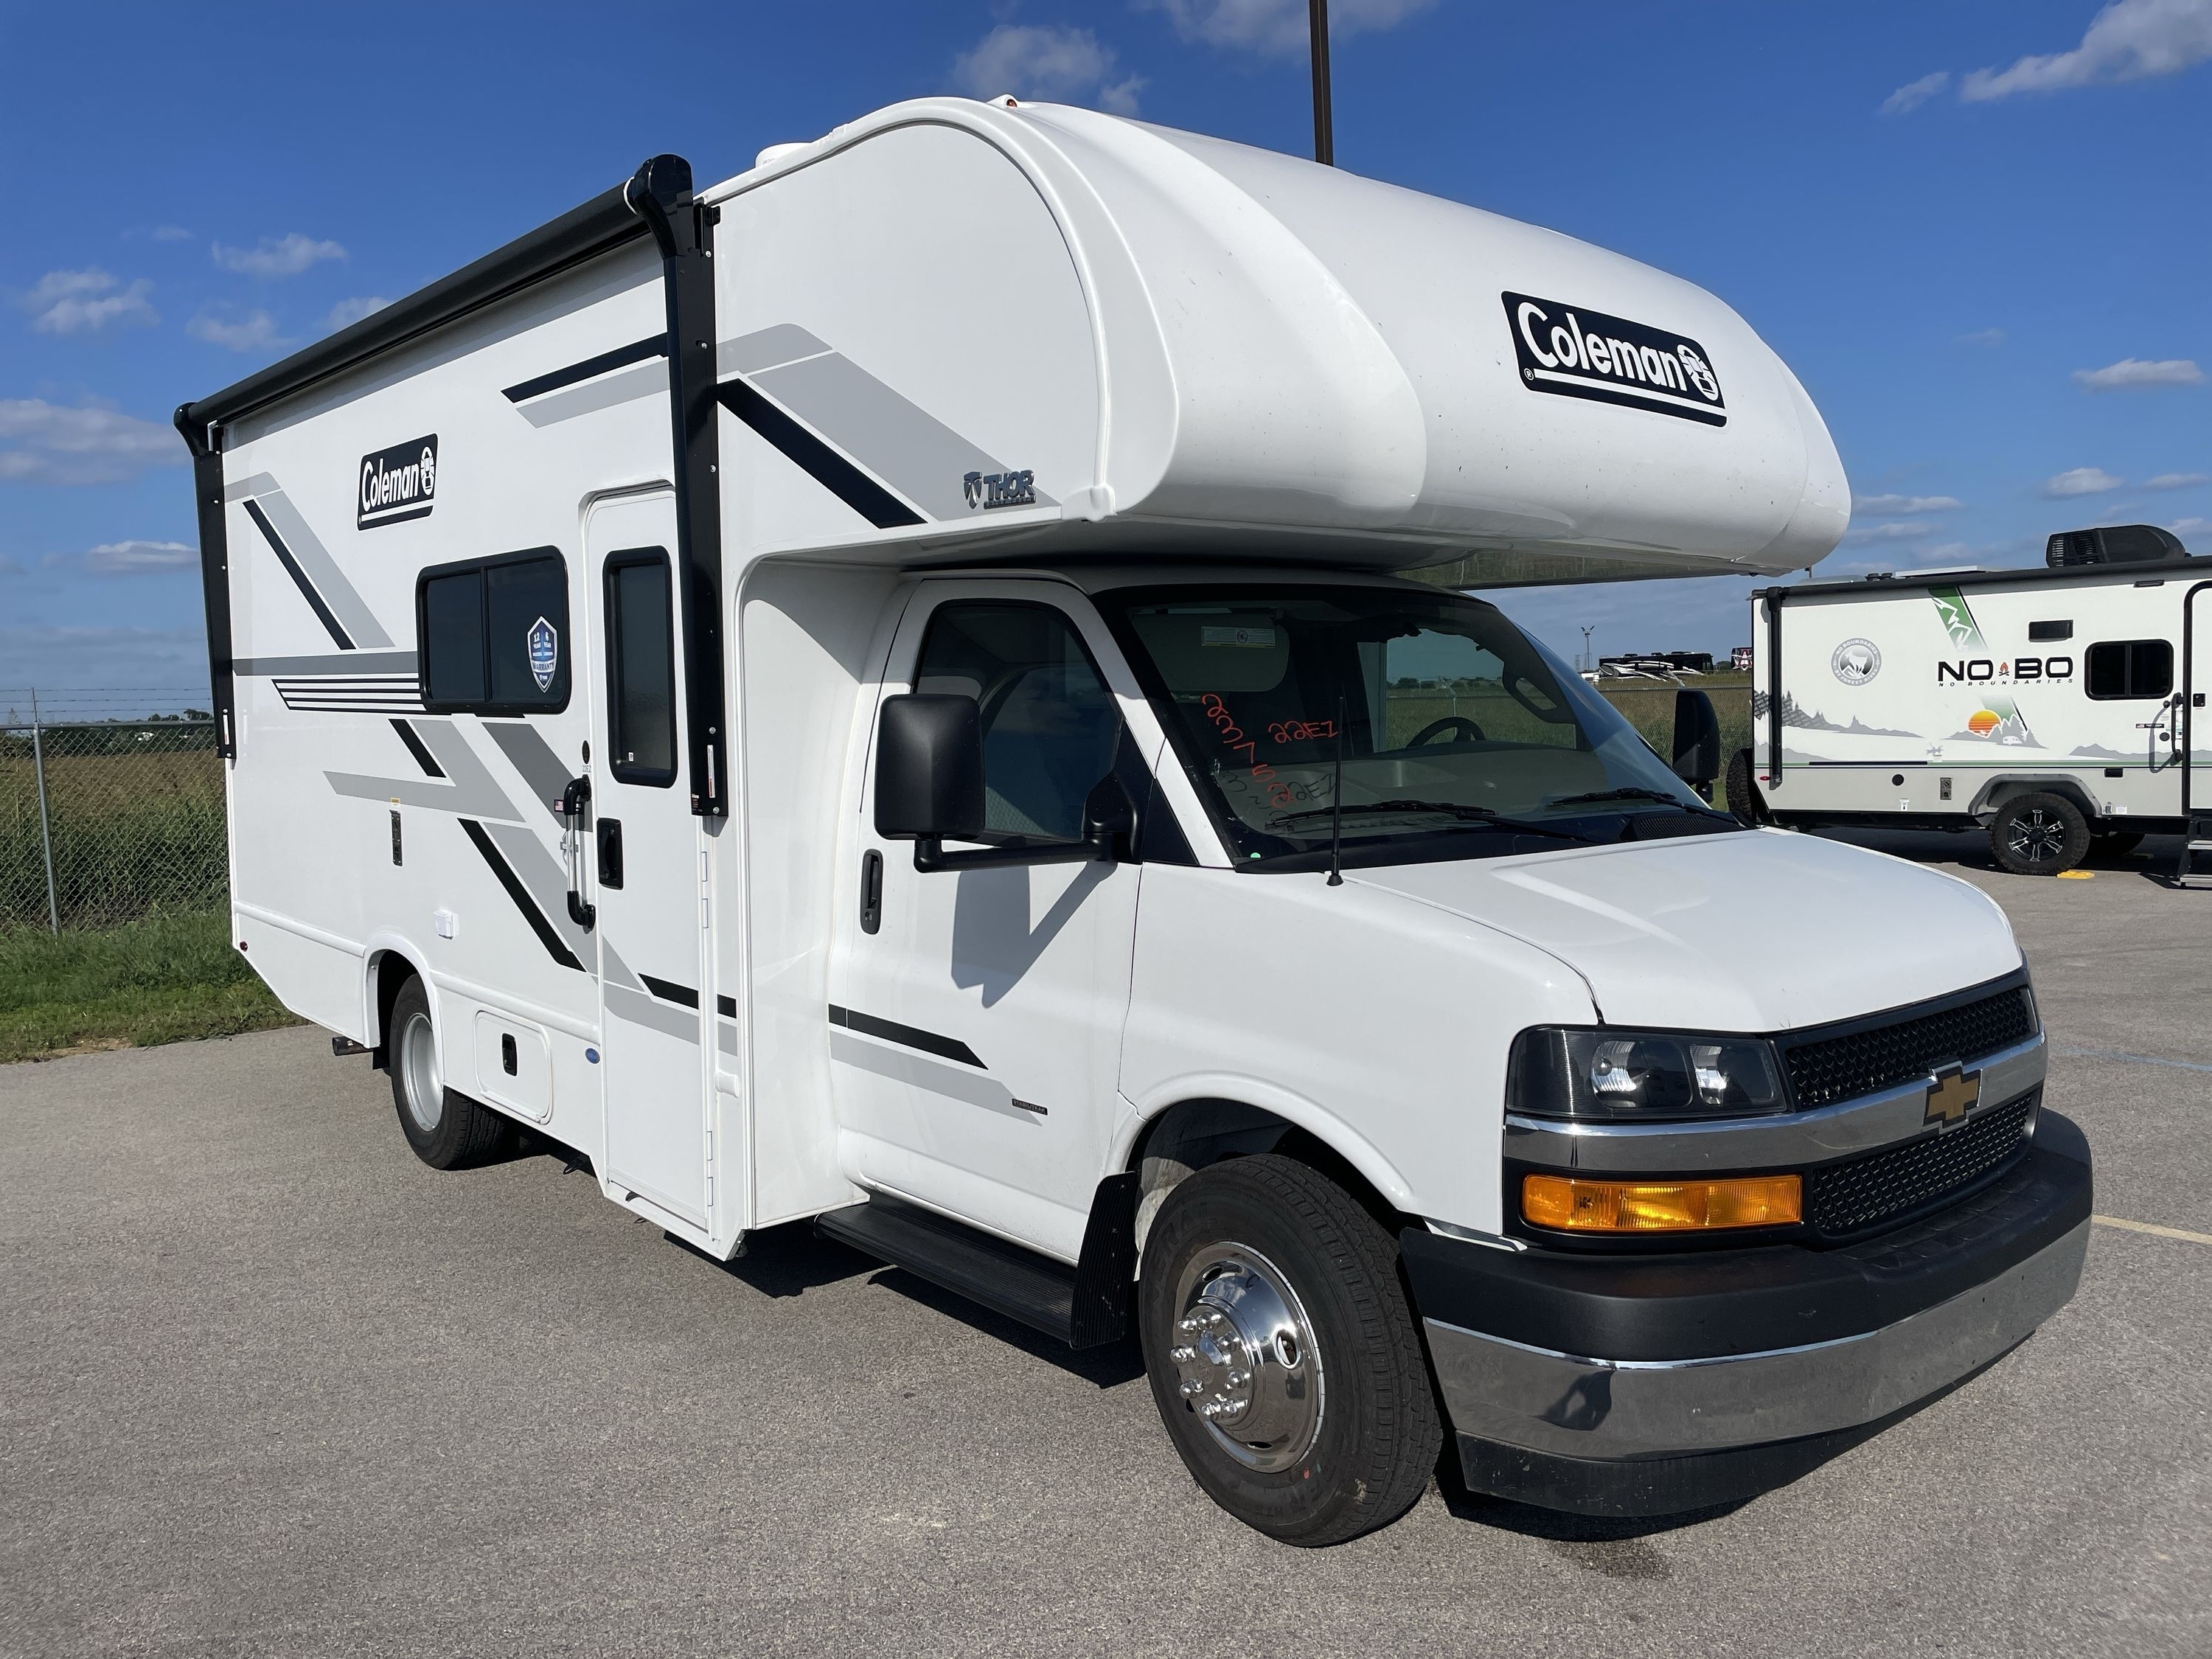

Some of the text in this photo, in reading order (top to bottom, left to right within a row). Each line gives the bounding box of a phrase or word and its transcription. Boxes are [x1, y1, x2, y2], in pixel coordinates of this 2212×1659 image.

[1517, 302, 1688, 392] Coleman
[361, 457, 420, 512] Coleman
[984, 470, 1035, 501] THOR
[533, 632, 540, 642] 12
[545, 631, 549, 641] 6
[1842, 639, 1878, 654] BOUNDARIES
[1938, 656, 2073, 682] NO BO
[1967, 678, 2073, 686] BOUNDARIES
